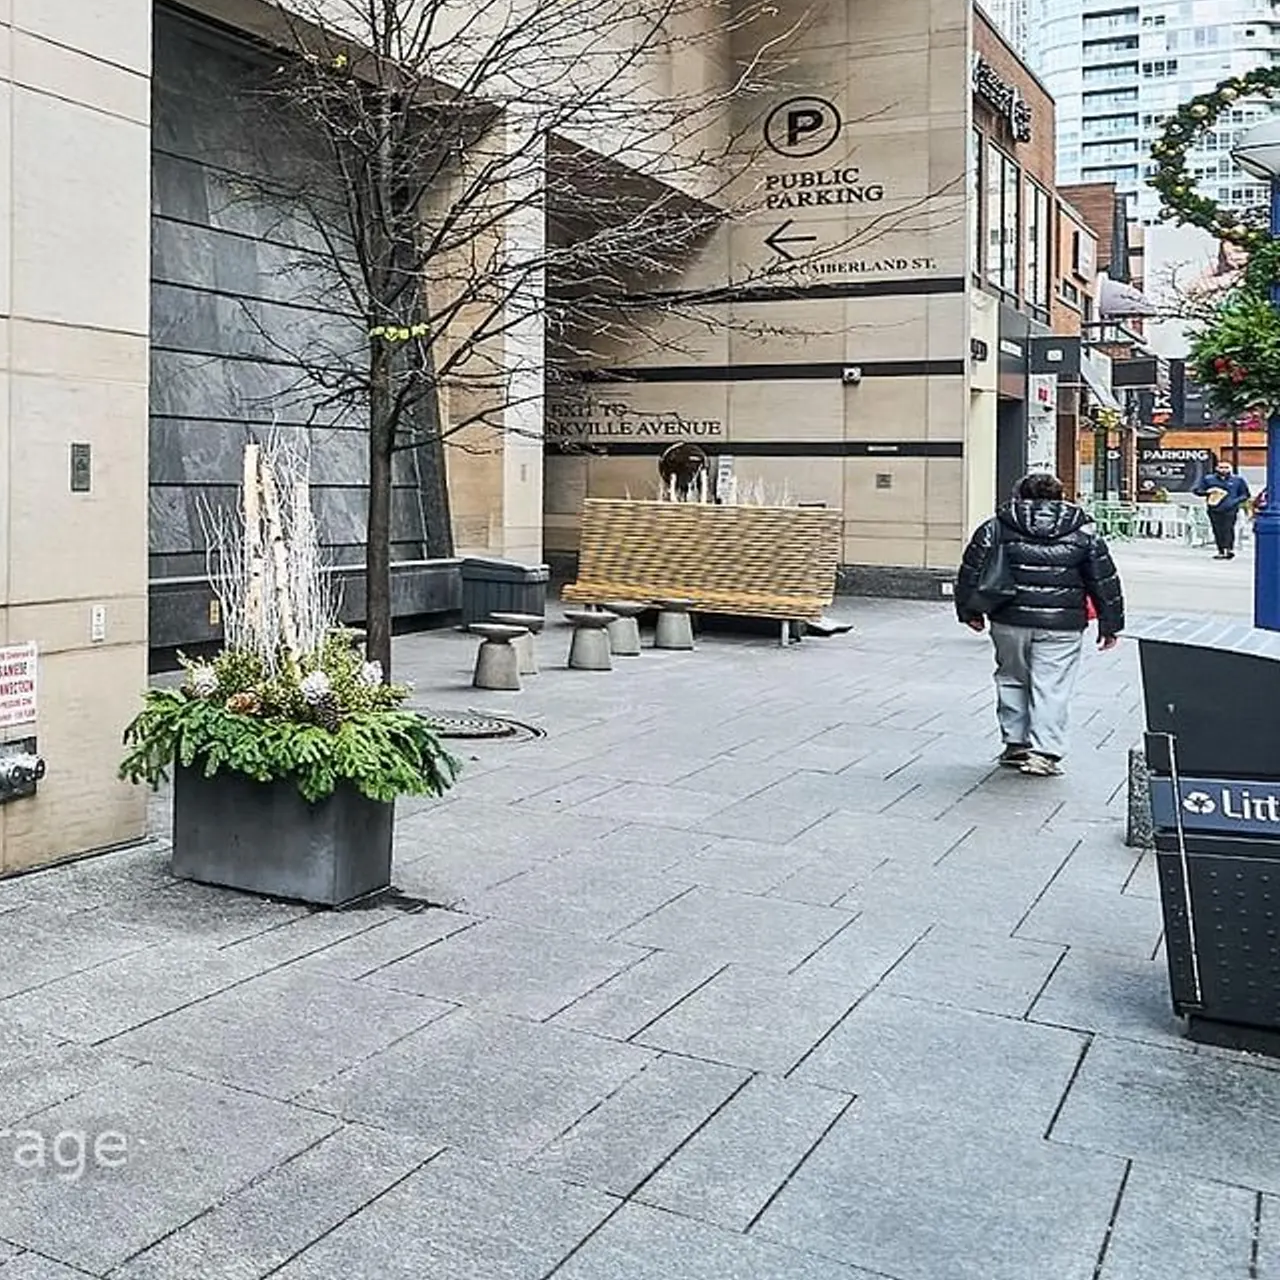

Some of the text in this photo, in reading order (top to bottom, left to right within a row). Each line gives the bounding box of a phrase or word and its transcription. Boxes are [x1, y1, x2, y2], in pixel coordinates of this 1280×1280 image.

[766, 168, 859, 191] PUBLIC
[766, 185, 883, 210] PARKING
[912, 258, 937, 270] ST.
[635, 422, 722, 436] AVENUE
[1143, 450, 1209, 461] PARKING
